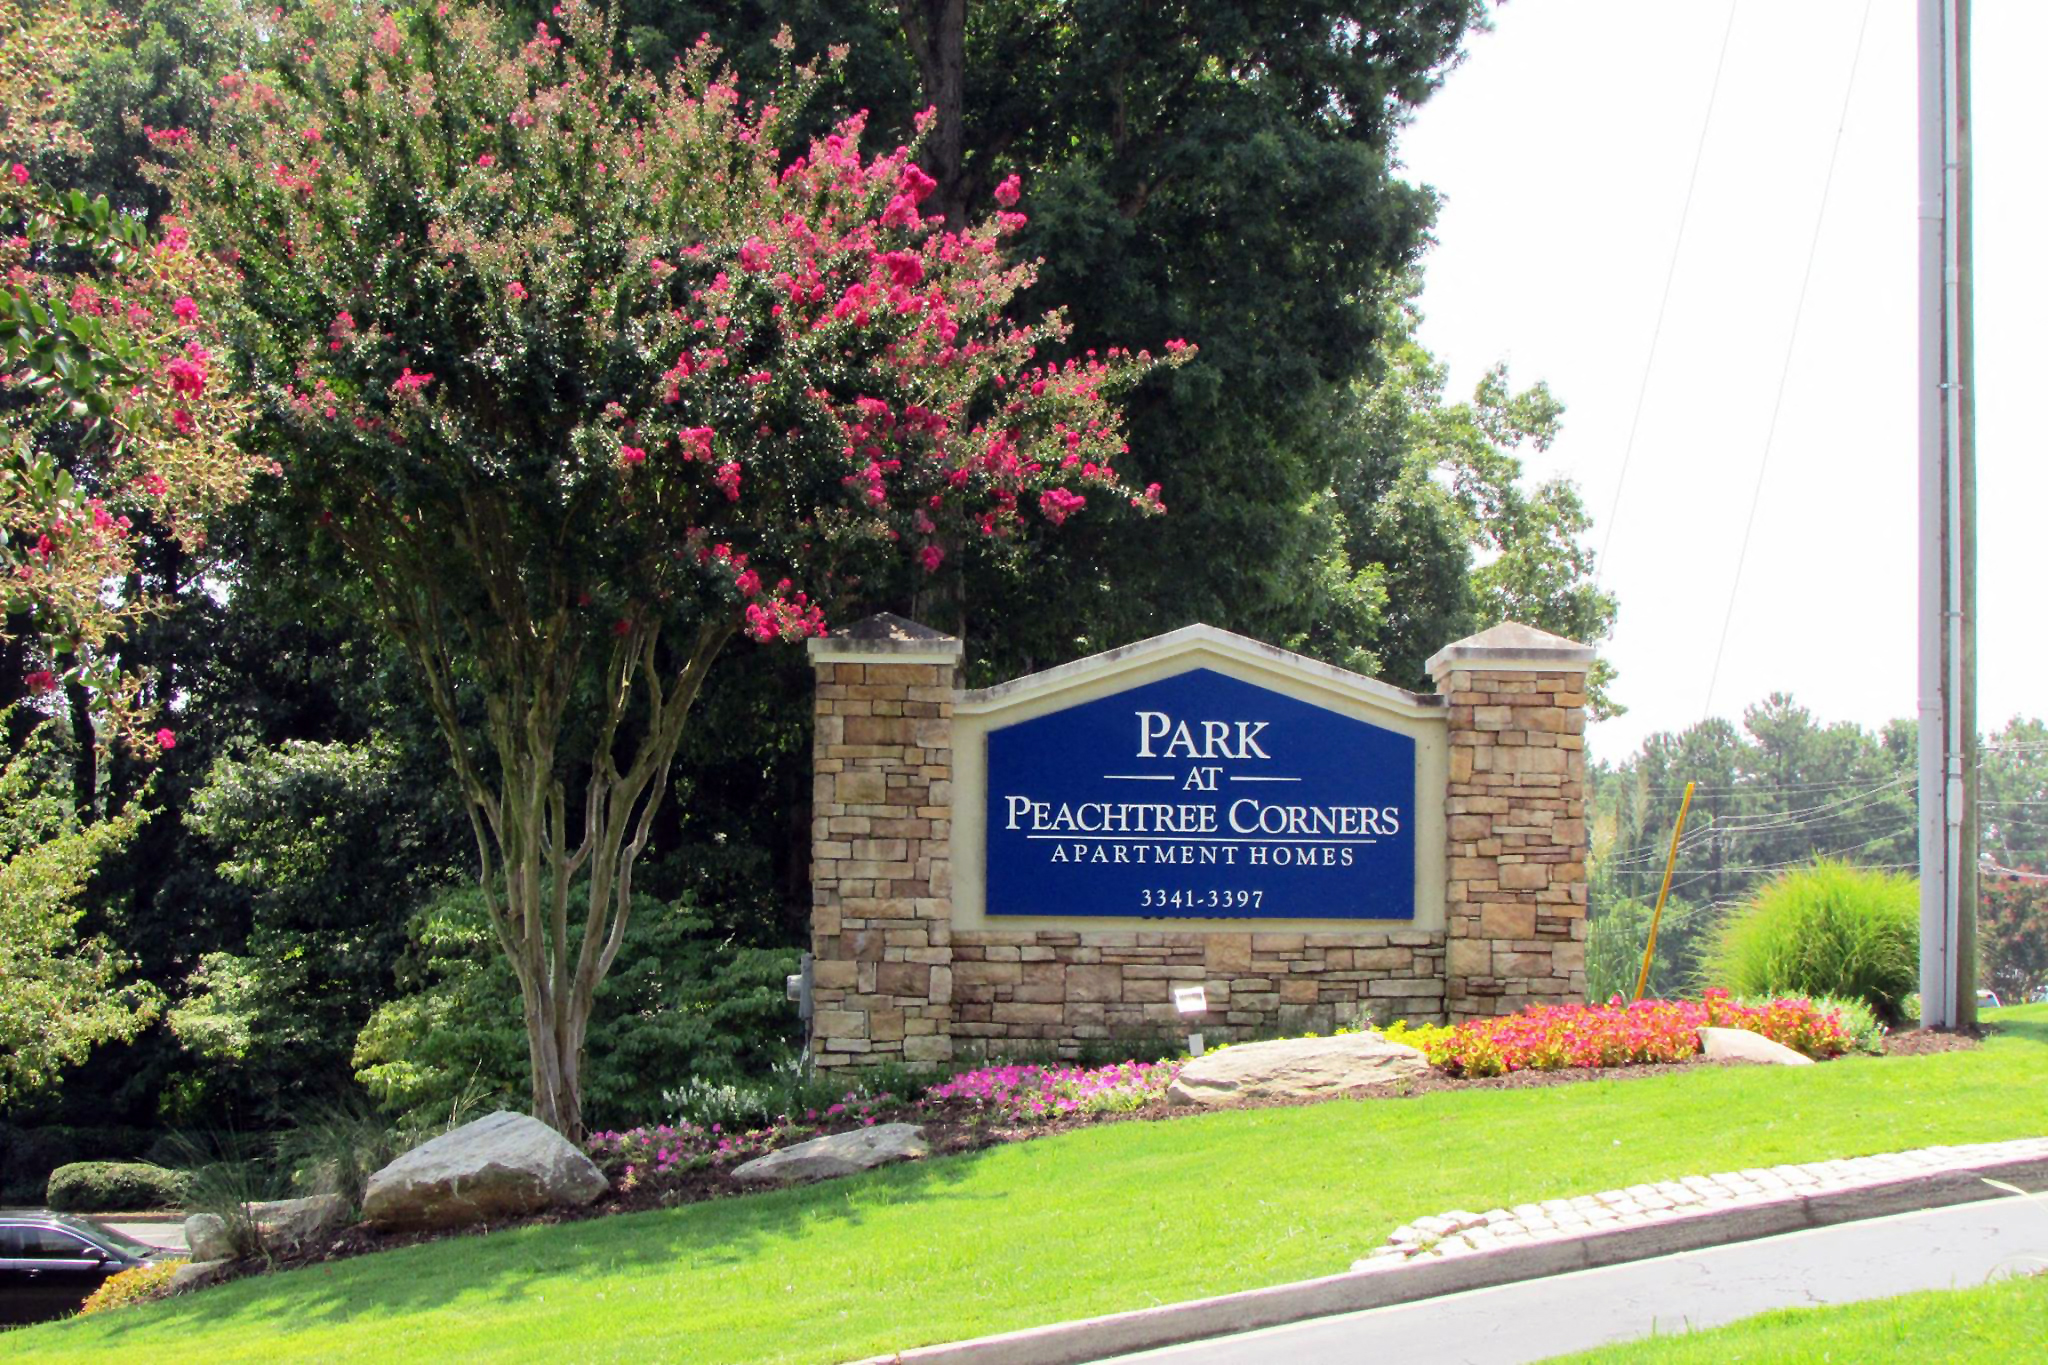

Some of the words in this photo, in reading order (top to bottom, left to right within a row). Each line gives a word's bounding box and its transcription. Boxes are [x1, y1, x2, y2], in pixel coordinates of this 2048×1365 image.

[1134, 711, 1272, 759] PARK
[1182, 766, 1224, 791] AT
[1004, 795, 1218, 832] PEACHTREE
[1228, 798, 1400, 835] CORNERS
[1050, 844, 1239, 866] APARTMENT
[1249, 846, 1353, 867] HOMES
[1141, 889, 1263, 909] 3341-3397
